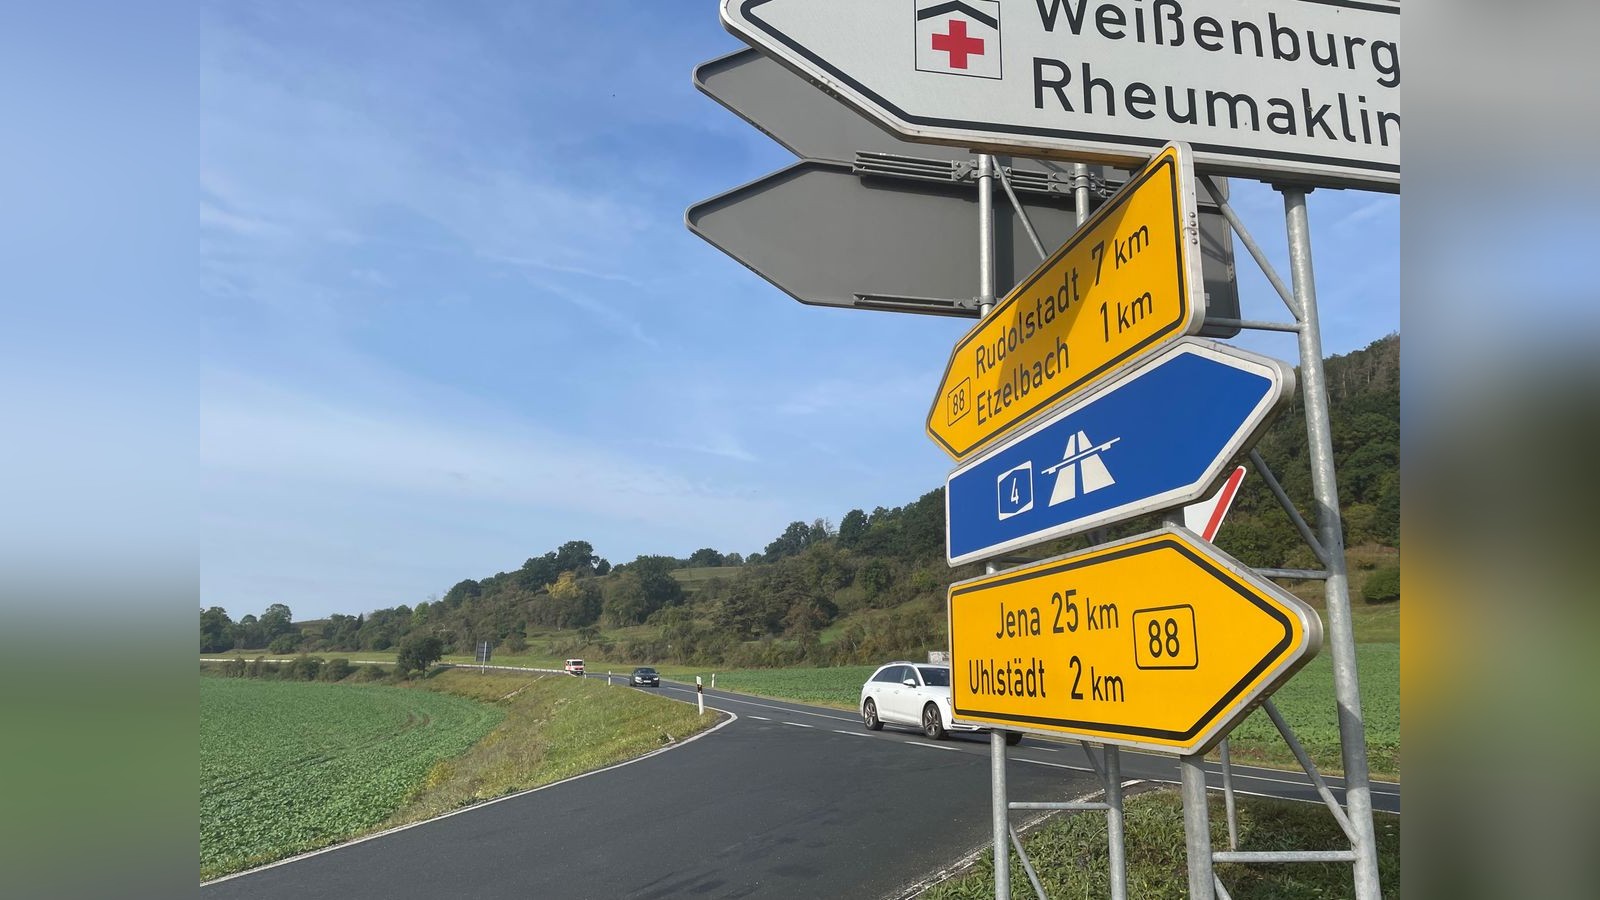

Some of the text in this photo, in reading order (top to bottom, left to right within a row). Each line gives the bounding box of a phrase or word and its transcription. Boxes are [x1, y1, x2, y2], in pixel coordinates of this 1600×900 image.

[1036, 0, 1400, 88] Weißenburg
[975, 224, 1150, 378] Rudolstadt 7 km
[976, 291, 1153, 426] Etzelbach 1 km
[951, 389, 965, 416] 88
[1010, 477, 1019, 505] 4
[996, 589, 1120, 639] Jena 25 km
[1148, 618, 1180, 658] 88
[969, 656, 1125, 702] Uhlstädt 2 km
